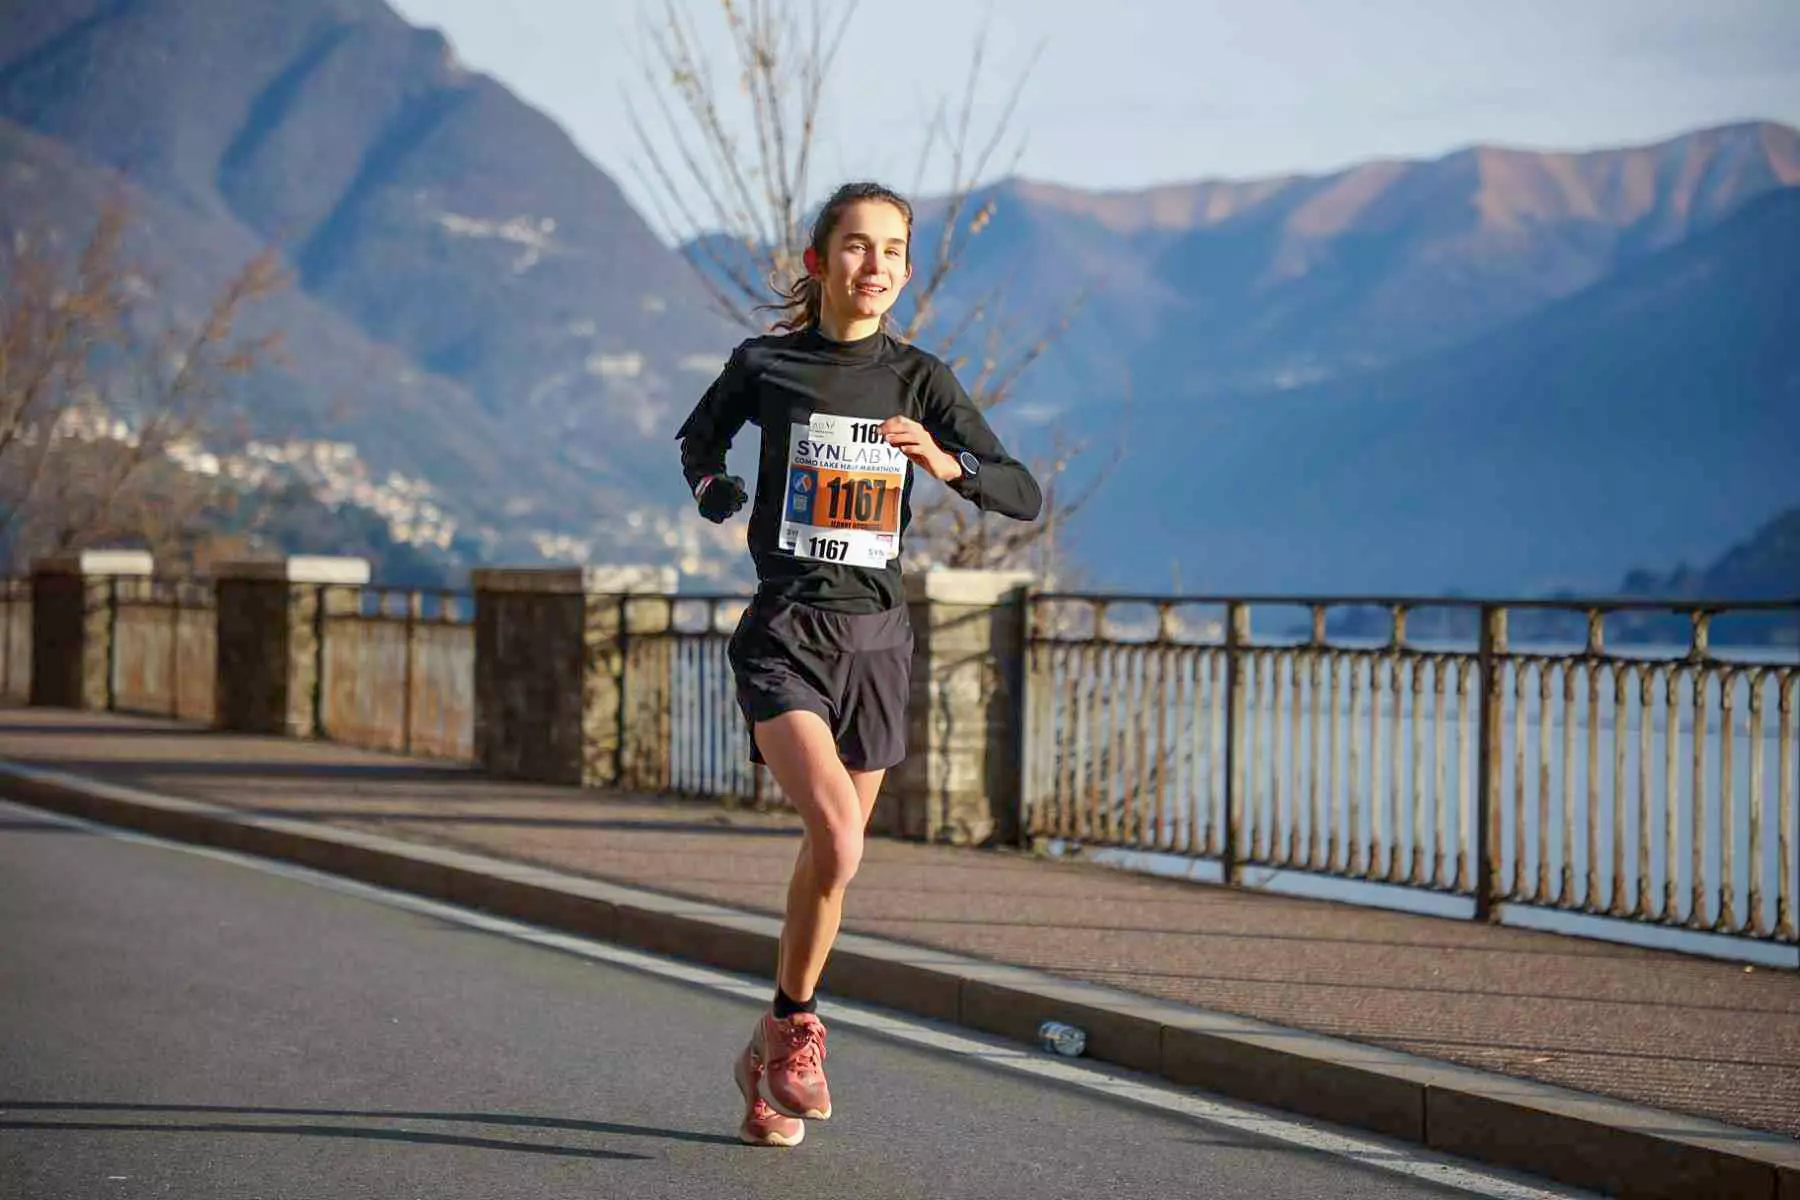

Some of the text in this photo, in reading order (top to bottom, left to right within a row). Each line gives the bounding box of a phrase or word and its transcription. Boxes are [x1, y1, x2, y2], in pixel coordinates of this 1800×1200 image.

[797, 440, 881, 464] SYNLAB
[794, 456, 818, 466] COMO
[820, 460, 839, 469] LAKE
[860, 465, 900, 473] MARATHON
[827, 476, 886, 522] 1167
[808, 536, 849, 561] 1167
